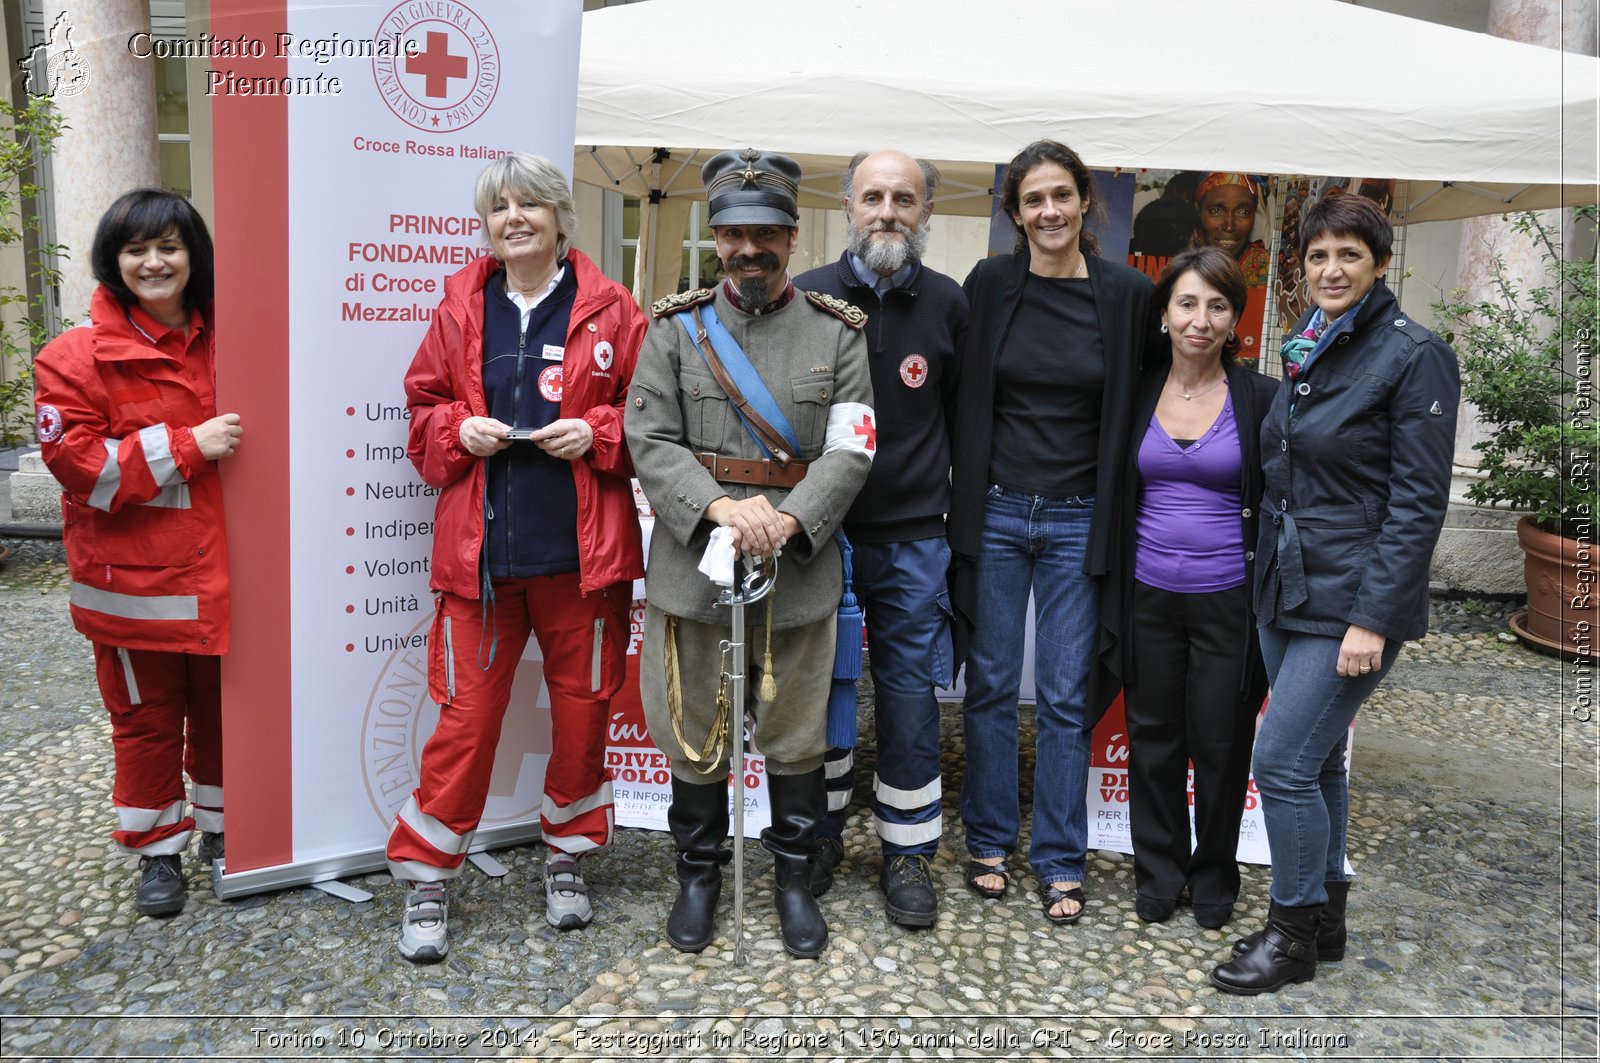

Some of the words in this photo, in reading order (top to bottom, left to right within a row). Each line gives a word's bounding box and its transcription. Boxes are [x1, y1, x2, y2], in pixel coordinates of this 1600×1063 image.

[391, 11, 409, 31] DI
[408, 1, 472, 31] GINEVRA
[471, 30, 490, 49] 22
[471, 52, 496, 108] AGOSTO
[446, 103, 475, 127] 1864
[353, 136, 400, 153] Croce
[405, 140, 454, 157] Rossa
[345, 273, 365, 292] di
[371, 273, 436, 293] Croce
[366, 443, 411, 464] Imp
[364, 556, 432, 578] Volont
[365, 594, 419, 616] Unità
[373, 651, 428, 817] ENZIONE
[1097, 810, 1121, 821] PER
